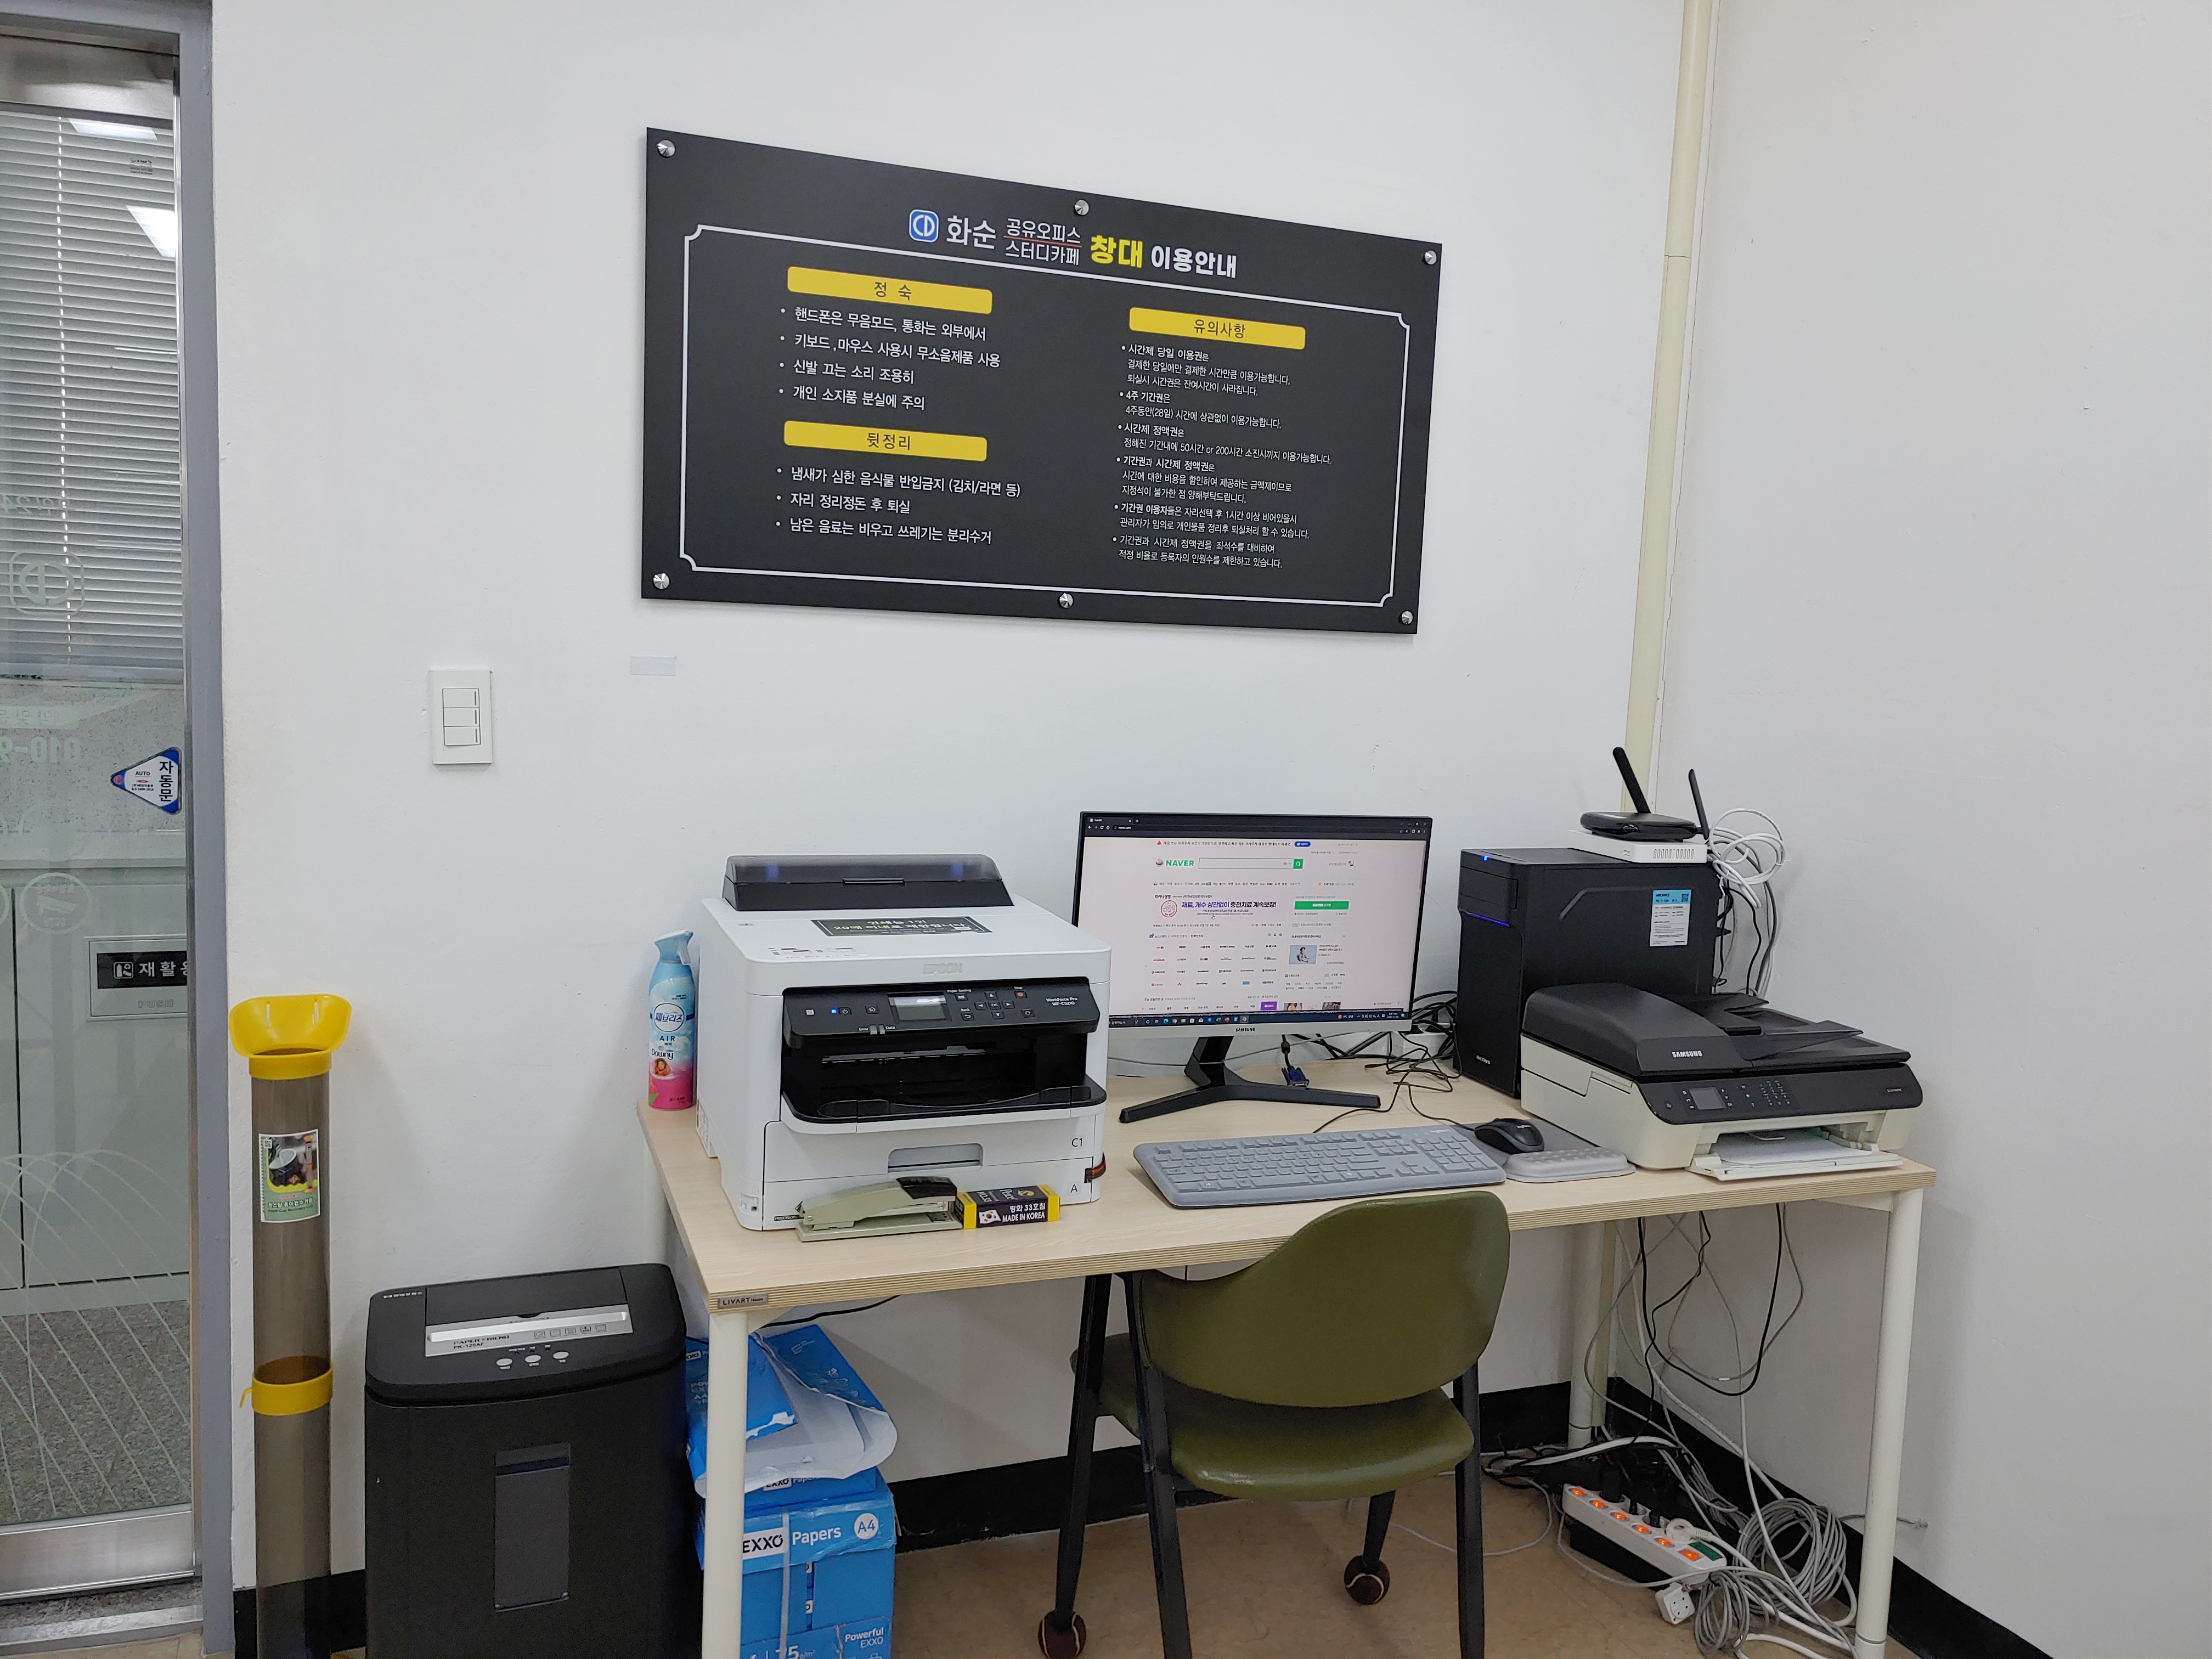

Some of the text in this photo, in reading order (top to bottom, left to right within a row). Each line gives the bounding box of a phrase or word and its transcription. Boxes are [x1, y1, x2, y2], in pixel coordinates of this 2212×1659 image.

[946, 215, 1238, 279] 화순 공유오피스 창대 이용안내
[1005, 243, 1080, 266] 스터디카페
[794, 307, 986, 341] 핸드폰은 무음모드, 통화는 외부에서
[1193, 319, 1246, 339] 유의사항
[877, 342, 912, 359] 사용시
[917, 346, 974, 365] 무소음제품
[977, 352, 1001, 368] 사용
[1128, 344, 1209, 362] 시간제 당일 이용권은
[793, 359, 914, 385] 신발 끄는 소리 조용히
[1127, 359, 1150, 371] 결제한
[1153, 362, 1182, 374] 당일에만
[1184, 365, 1207, 376] 결제한
[1208, 367, 1238, 380] 시간만큼
[1127, 374, 1149, 385] 퇴실시
[1152, 376, 1182, 388] 시간권은
[1183, 379, 1219, 392] 잔여시간이
[793, 385, 924, 411] 개인 소지품 분실에 주의
[1126, 390, 1171, 404] 4주 기간권은
[1175, 410, 1198, 421] 시간에
[1199, 412, 1228, 425] 상관없이
[1124, 422, 1184, 437] 시간제 정액권은
[866, 432, 912, 451] 뒷정리
[1124, 437, 1147, 449] 정해진
[1149, 439, 1178, 452] 기간내에
[1180, 443, 1204, 454] 50시간
[1215, 445, 1244, 457] 200시간
[1244, 448, 1280, 461] 소진시까지
[1123, 455, 1215, 472] 기간권과 시간제 정액권은
[792, 466, 1020, 498] 냄새가 심한 음식물 반입금지 (김치/라면 등)
[1122, 470, 1292, 492] 시간에 대한 비용을 할인하여 제공하는 금액제이므로
[1121, 484, 1152, 497] 지정석이
[1153, 487, 1176, 498] 불가한
[1178, 489, 1186, 499] 점
[790, 492, 910, 514] 자리 정리정돈 후 퇴실
[1121, 503, 1297, 524] 기간권 이용자들은 자리선택 후 1시간 이상 비어있을시
[790, 517, 991, 545] 남은 음료는 비우고 쓰레기는 분리수거
[1120, 517, 1150, 529] 관리자가
[1152, 520, 1175, 530] 임의로
[1176, 521, 1205, 532] 개인물품
[1207, 523, 1229, 534] 정리후
[1231, 524, 1259, 536] 퇴실처리
[1262, 526, 1269, 537] 할
[1271, 527, 1279, 537] 수
[1120, 535, 1274, 554] 기간권과 시간제 정액권을 좌석수를 대비하여
[1119, 549, 1134, 560] 적정
[1136, 550, 1158, 561] 비율로
[1160, 552, 1189, 563] 등록자의
[1192, 554, 1221, 565] 인원수를
[1222, 556, 1251, 566] 제한하고
[159, 760, 174, 802] 자동문
[923, 962, 963, 975] EPSON
[654, 1012, 683, 1023] 페브리즈
[651, 1048, 674, 1060] Downy
[1071, 1137, 1084, 1148] C1
[1070, 1184, 1078, 1194] A
[1002, 1214, 1019, 1222] MADE
[1026, 1212, 1045, 1220] KOREA
[1009, 1203, 1046, 1213] 평화 33호침
[743, 1519, 877, 1554] EXXO Papers A4
[845, 1627, 884, 1643] Powerful
[860, 1637, 884, 1649] EXXO
